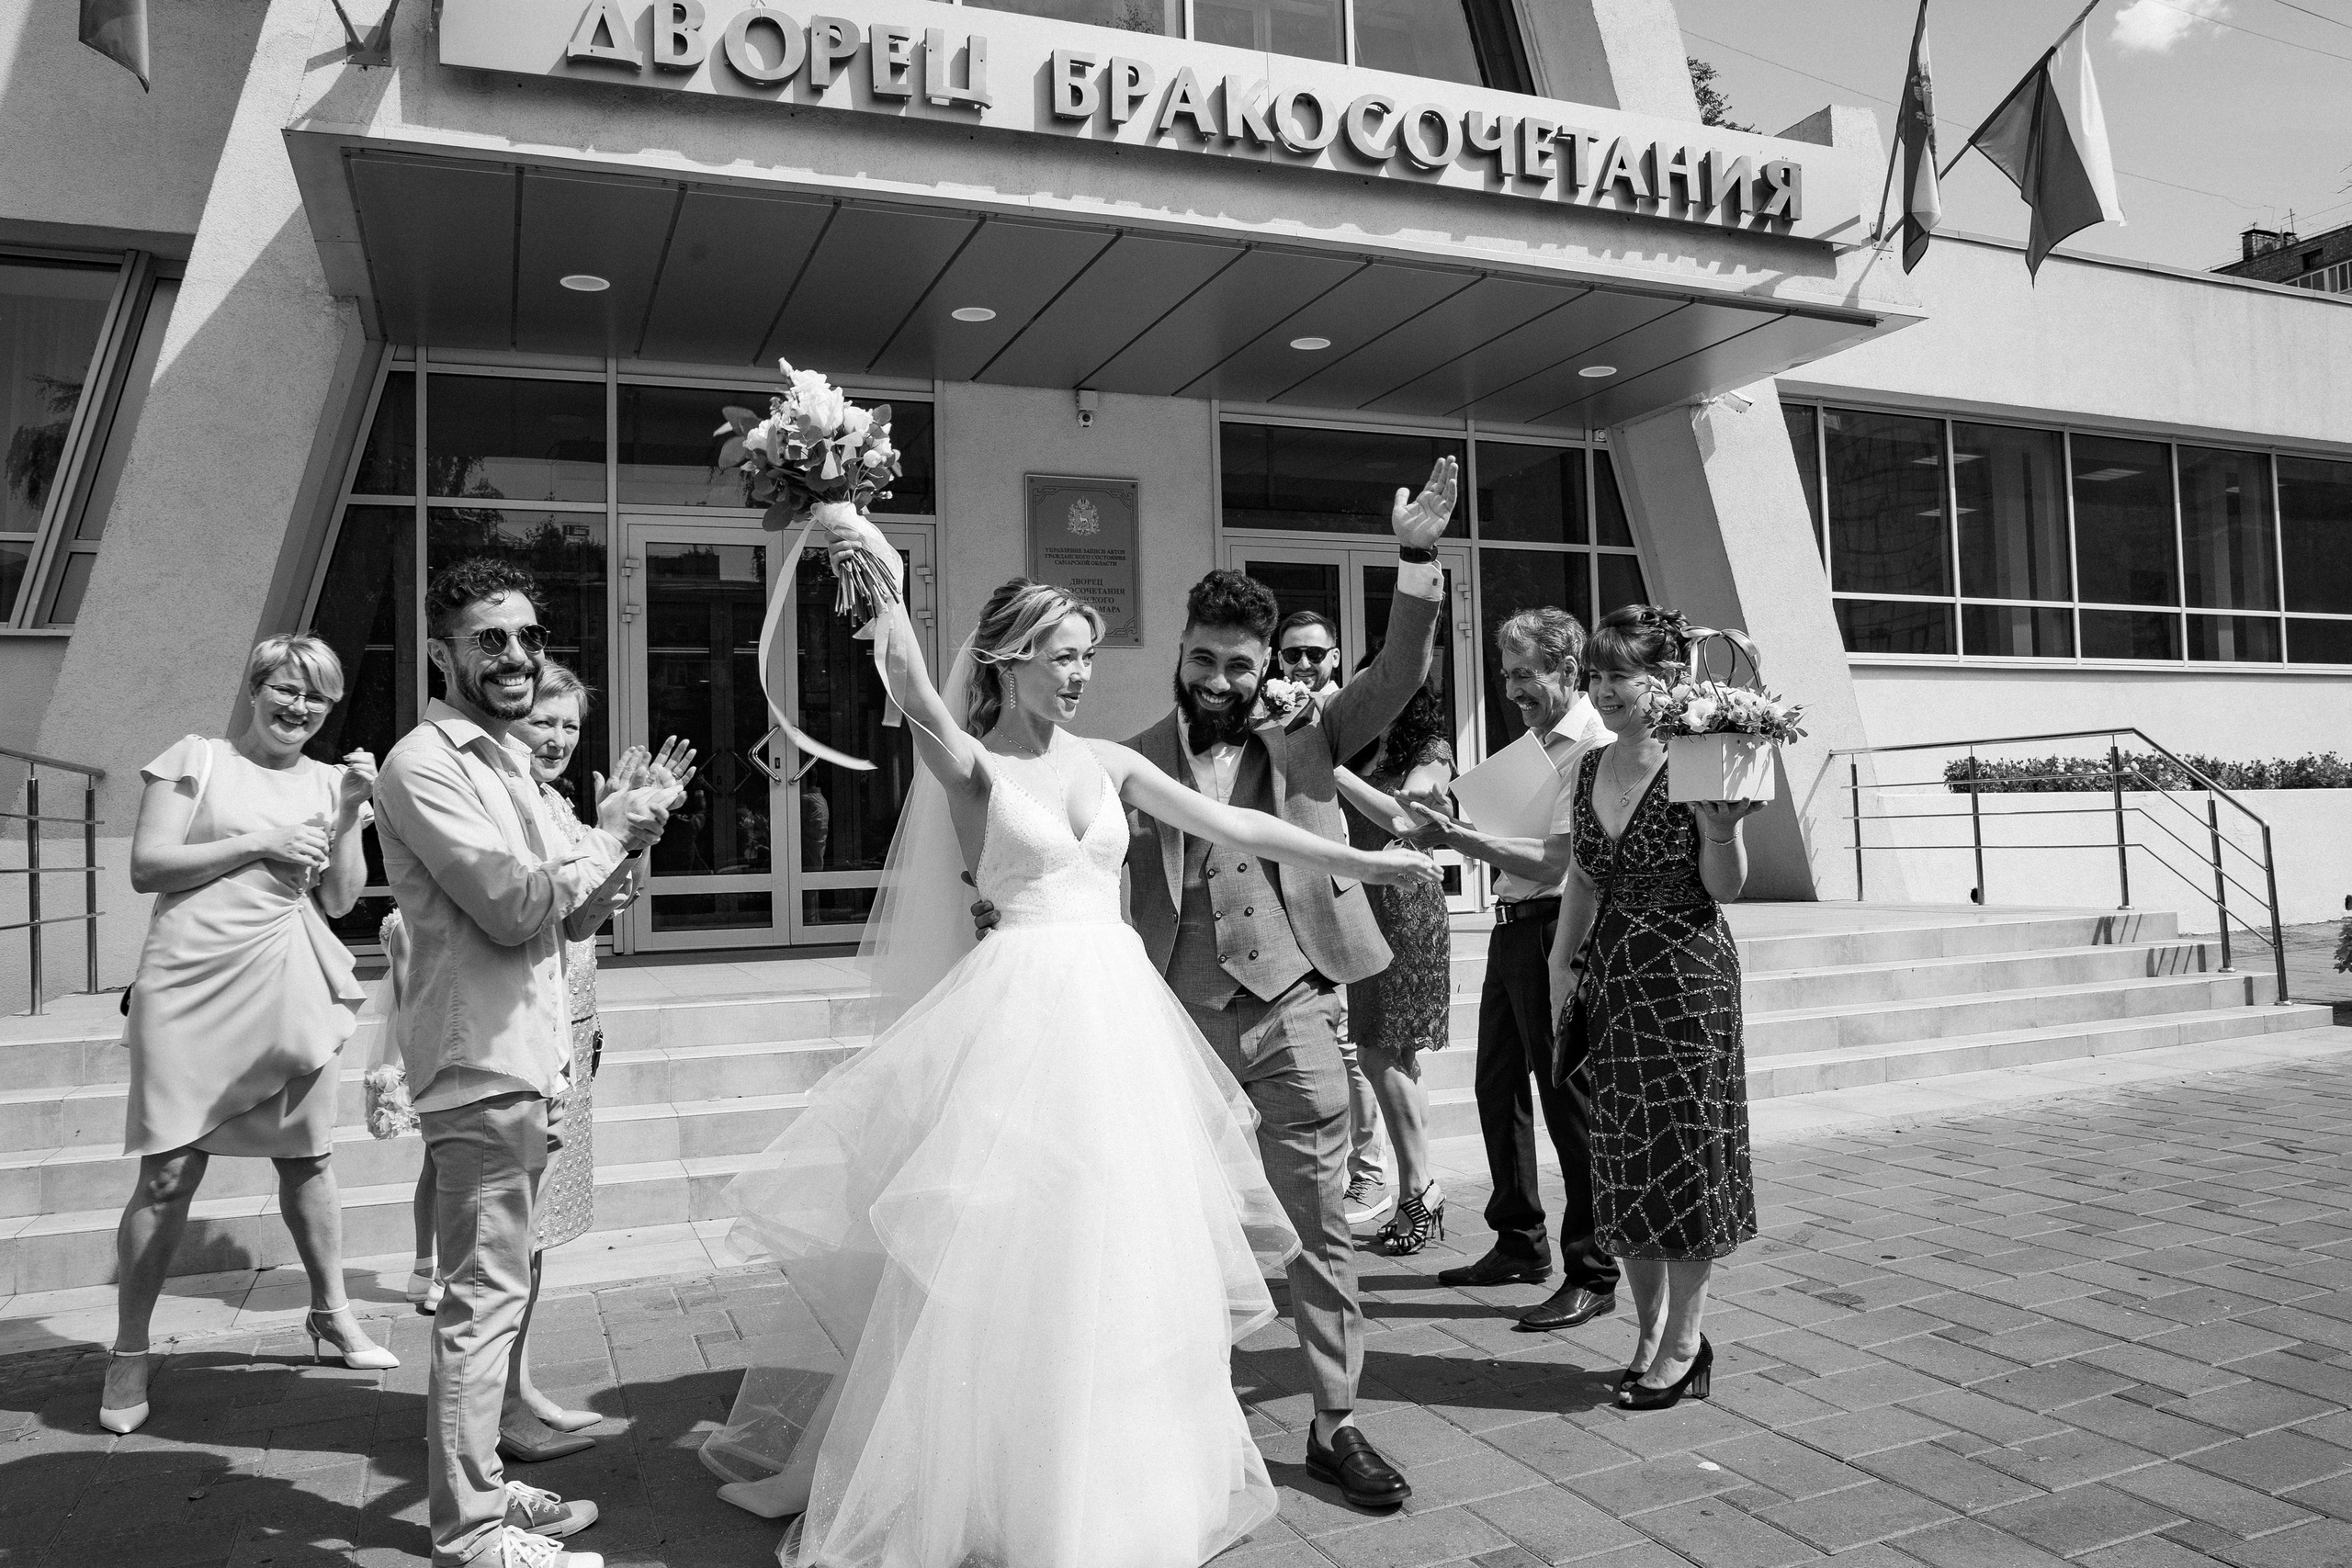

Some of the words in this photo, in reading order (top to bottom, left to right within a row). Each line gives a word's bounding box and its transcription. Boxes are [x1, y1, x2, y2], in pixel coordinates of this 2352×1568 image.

[566, 0, 993, 109] ДВОРЕЦ
[1052, 49, 1803, 222] БРАКОСОЧЕТАНИЯ
[1069, 579, 1103, 587] ДВОРЕЦ
